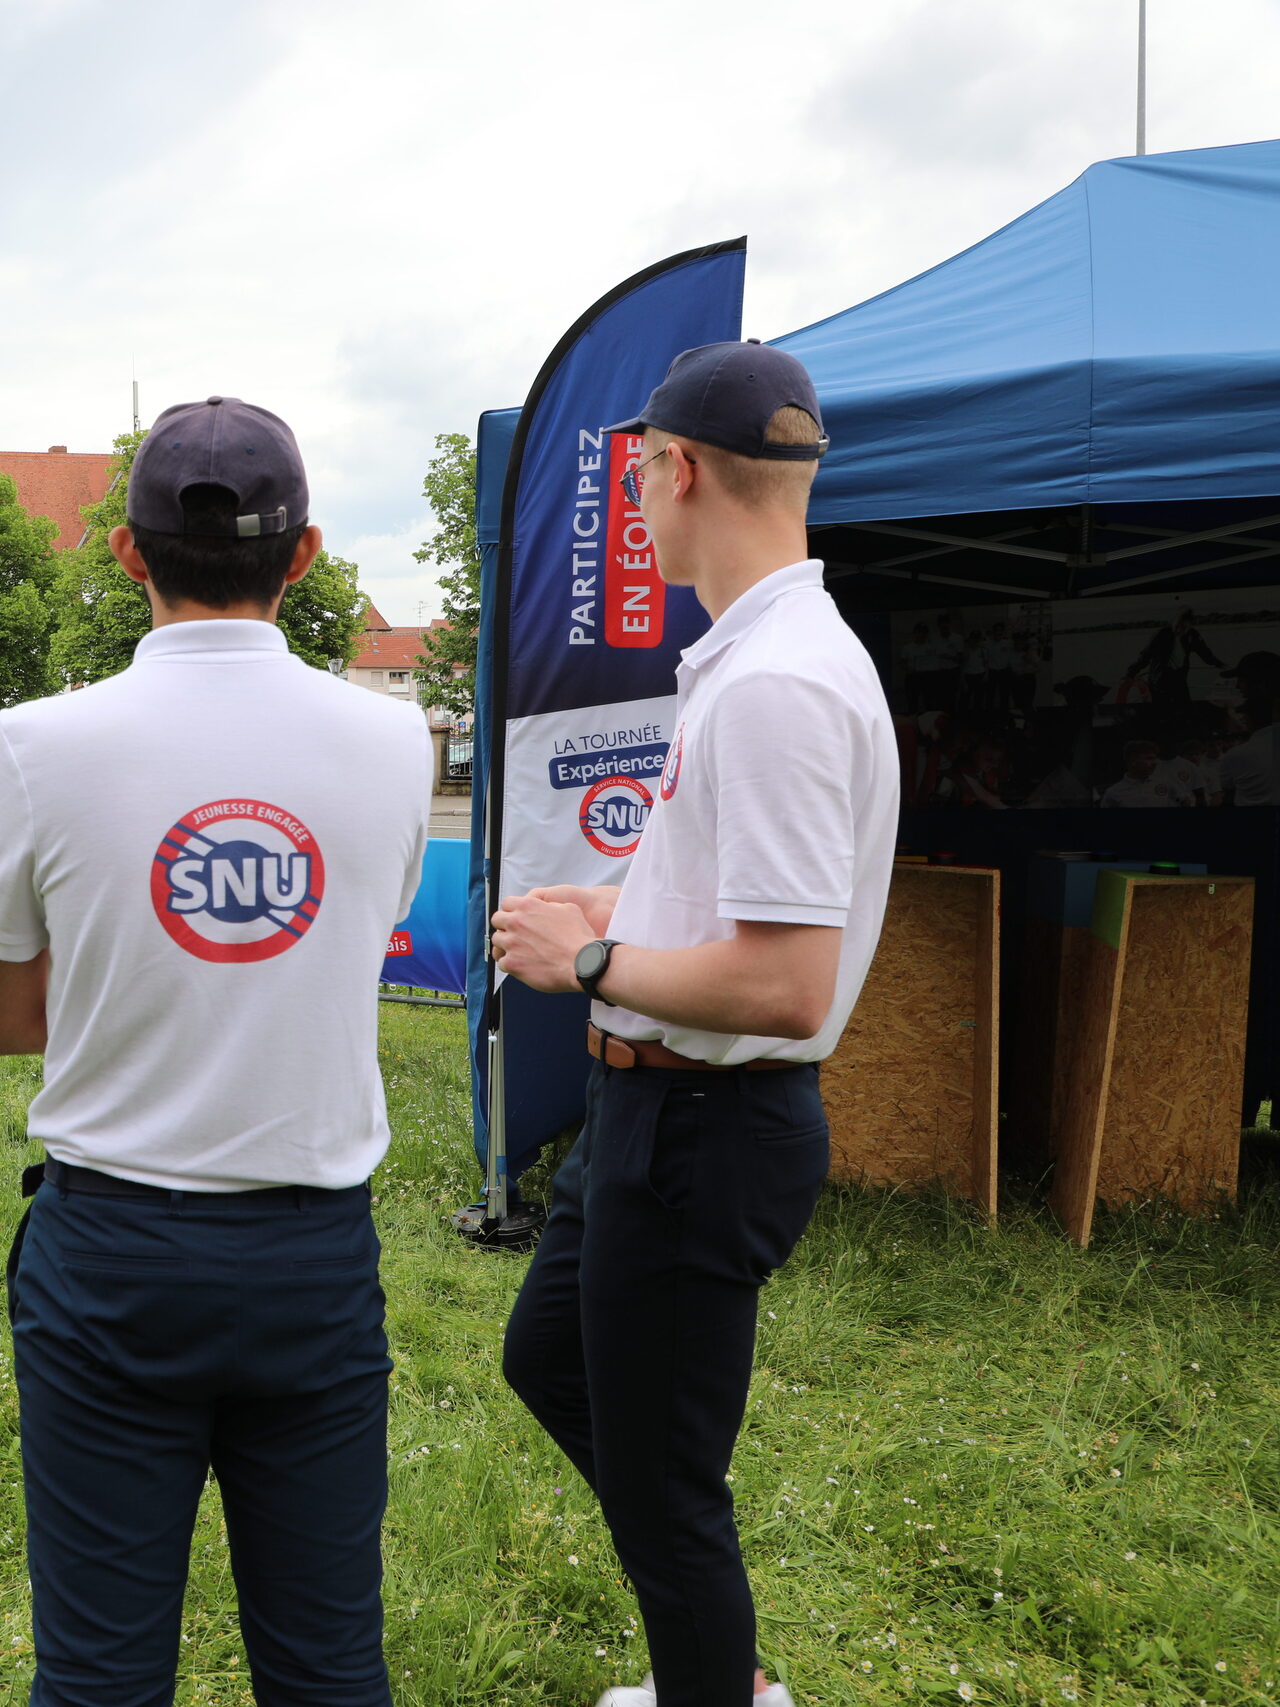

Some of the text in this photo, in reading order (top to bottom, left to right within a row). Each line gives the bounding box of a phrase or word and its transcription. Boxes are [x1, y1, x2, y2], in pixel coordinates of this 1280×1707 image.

[569, 426, 604, 645] PARTICIPEZ
[622, 585, 651, 633] EN
[554, 722, 663, 755] LA TOURNÉE
[557, 754, 665, 784] Expérience
[593, 779, 646, 795] SERVICE NATIONAL
[192, 803, 309, 844] JEUNESSE ENGAGÉE
[587, 801, 650, 832] SNU
[169, 856, 308, 911] SNU
